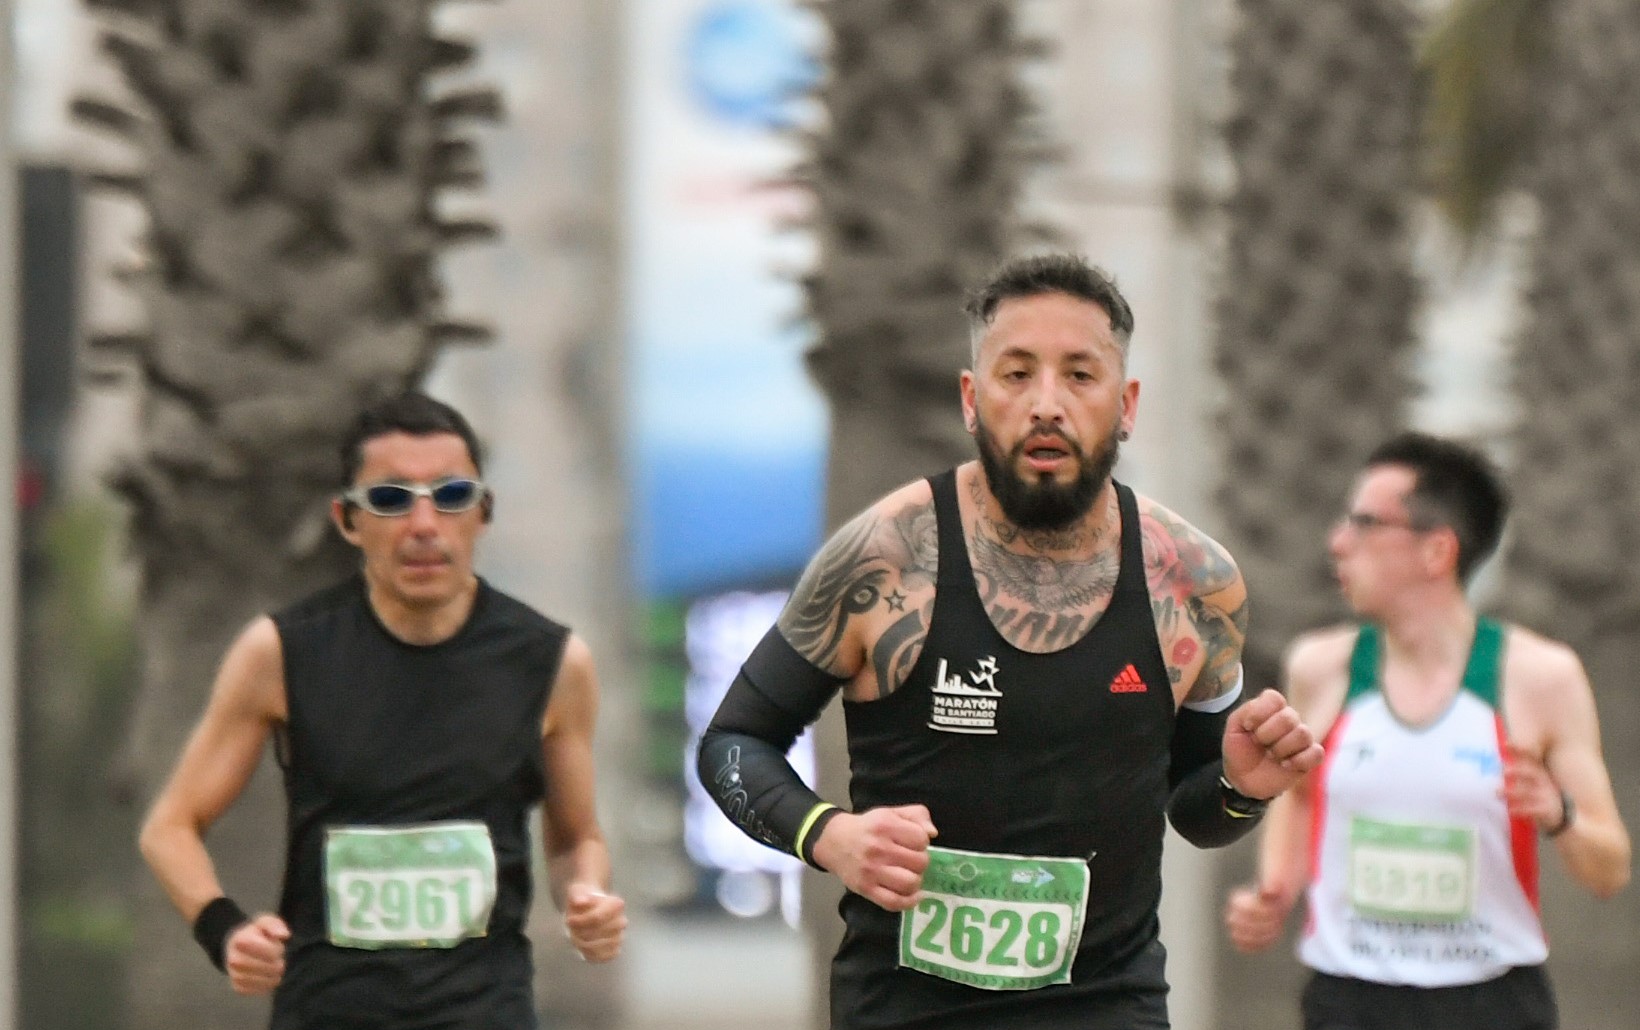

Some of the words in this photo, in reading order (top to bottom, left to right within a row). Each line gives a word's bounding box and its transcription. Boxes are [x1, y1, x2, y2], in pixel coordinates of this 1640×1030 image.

[933, 706, 946, 715] DE
[947, 708, 996, 718] SANTIAGO
[934, 696, 998, 710] MARATÓN
[348, 876, 472, 931] 2961
[915, 898, 1061, 969] 2628
